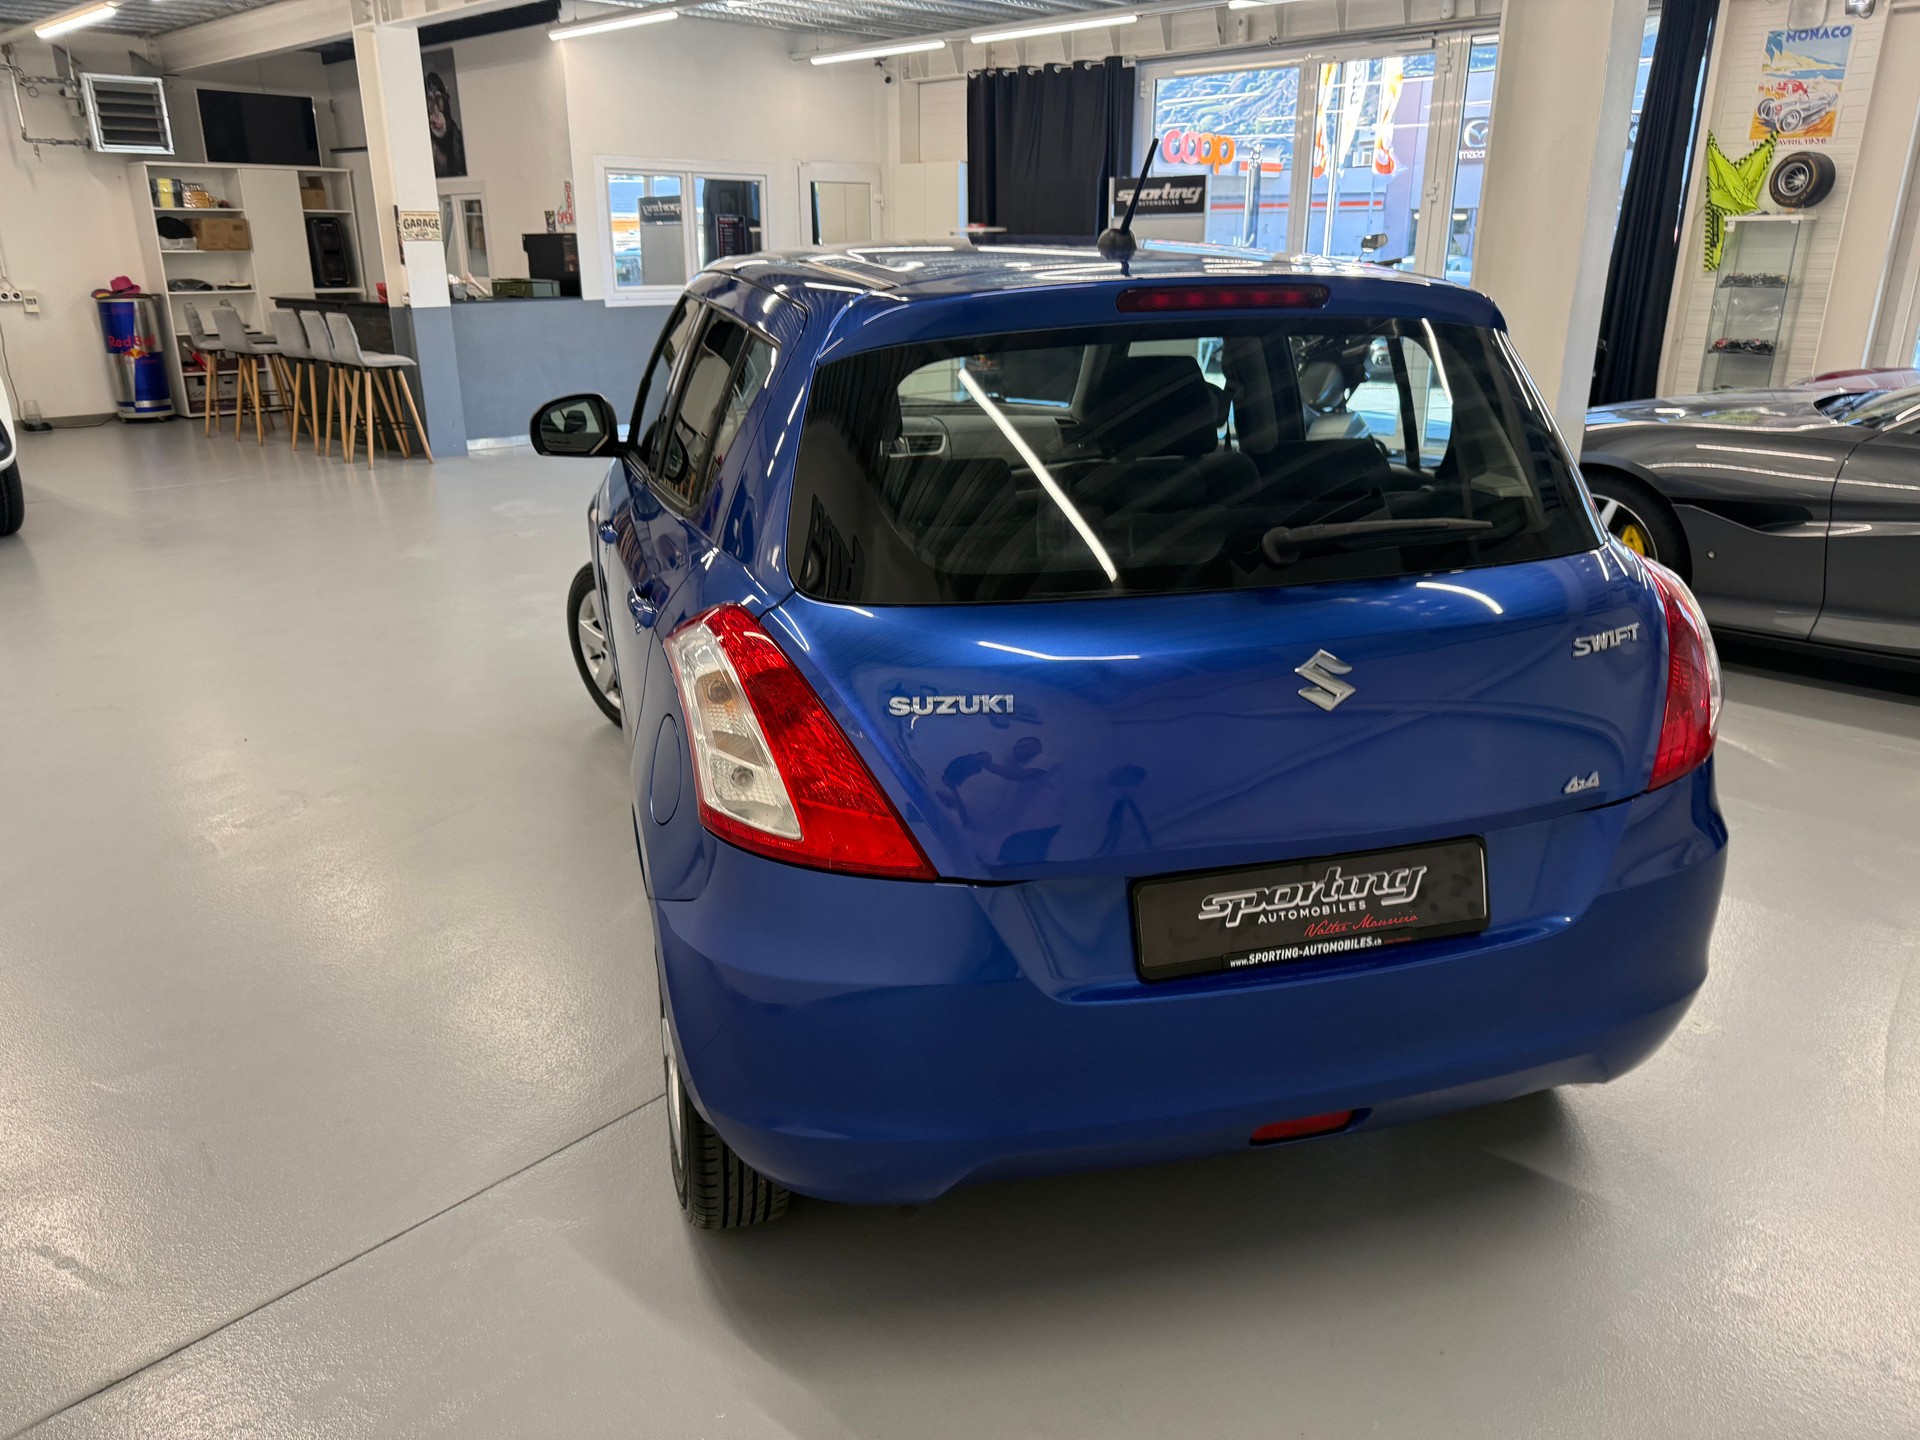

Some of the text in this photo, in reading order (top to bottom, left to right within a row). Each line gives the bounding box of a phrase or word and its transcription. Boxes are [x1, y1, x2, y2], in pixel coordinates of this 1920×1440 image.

[1785, 26, 1851, 42] MONACO
[1459, 150, 1486, 160] mazd
[403, 219, 440, 230] GARAGE
[108, 336, 132, 347] Red
[1572, 622, 1639, 657] SWIFT
[888, 694, 1014, 716] SUZUKI
[1563, 770, 1599, 794] 4x4
[1198, 866, 1427, 928] sporting
[1257, 900, 1366, 924] AUTOMOBILES
[1230, 936, 1382, 968] www.SPORTING-AUTOMOBILES.ch
